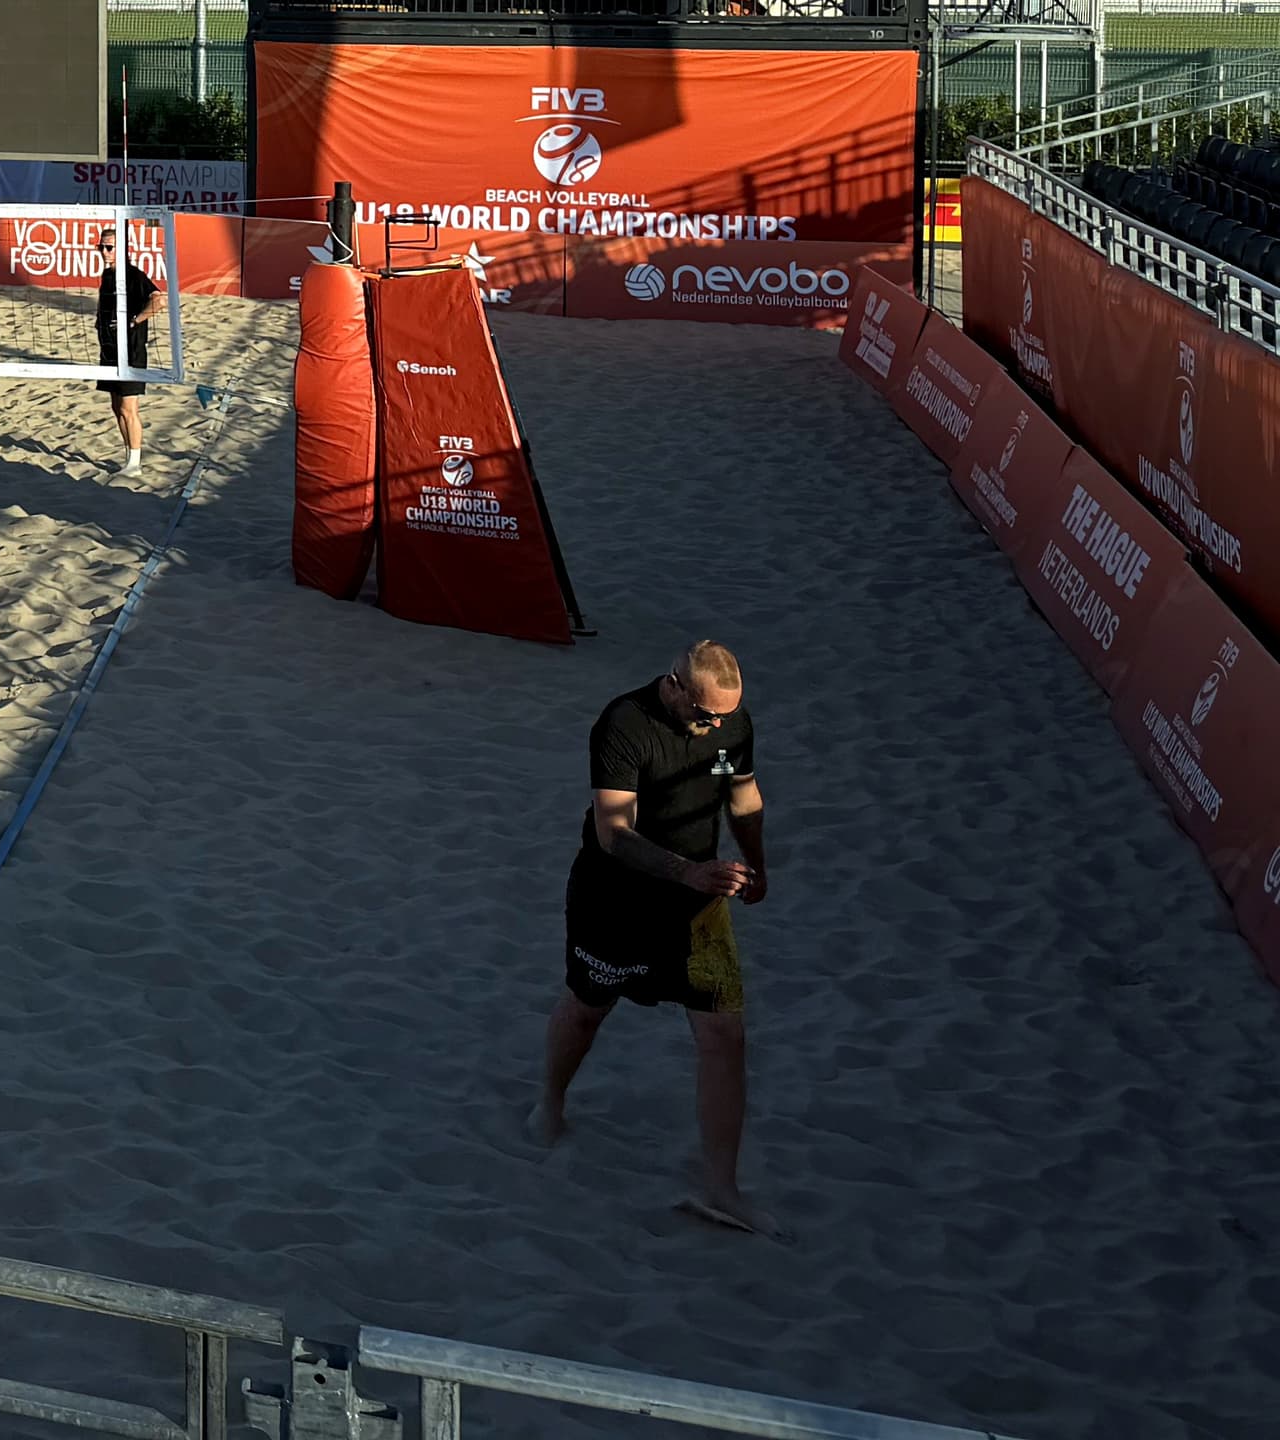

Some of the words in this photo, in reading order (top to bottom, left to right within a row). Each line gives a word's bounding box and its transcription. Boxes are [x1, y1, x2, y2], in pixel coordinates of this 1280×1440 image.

[870, 30, 884, 39] 10
[531, 87, 605, 111] FIVB
[74, 162, 240, 189] SPORTCAMPUS
[486, 189, 541, 203] BEACH
[545, 191, 650, 207] VOLLEYBALL
[356, 201, 414, 224] U18
[422, 203, 529, 233] WORLD
[538, 207, 796, 241] CHAMPIONSHIPS
[14, 221, 163, 252] VOLLEYALL
[672, 261, 850, 296] nevobo
[672, 293, 753, 305] Nederlandse
[757, 294, 848, 309] Volleybalbond
[410, 363, 457, 376] Senoh
[439, 436, 474, 450] FIVB
[420, 494, 447, 510] U18
[449, 497, 500, 514] WORLD
[422, 486, 447, 495] BEACH
[449, 488, 496, 499] VOLLEYBALL
[406, 507, 518, 531] CHAMPIONSHIPS
[1061, 484, 1100, 545] THE
[1085, 509, 1151, 599] HAGUE
[1038, 540, 1120, 650] NETHERLANDS
